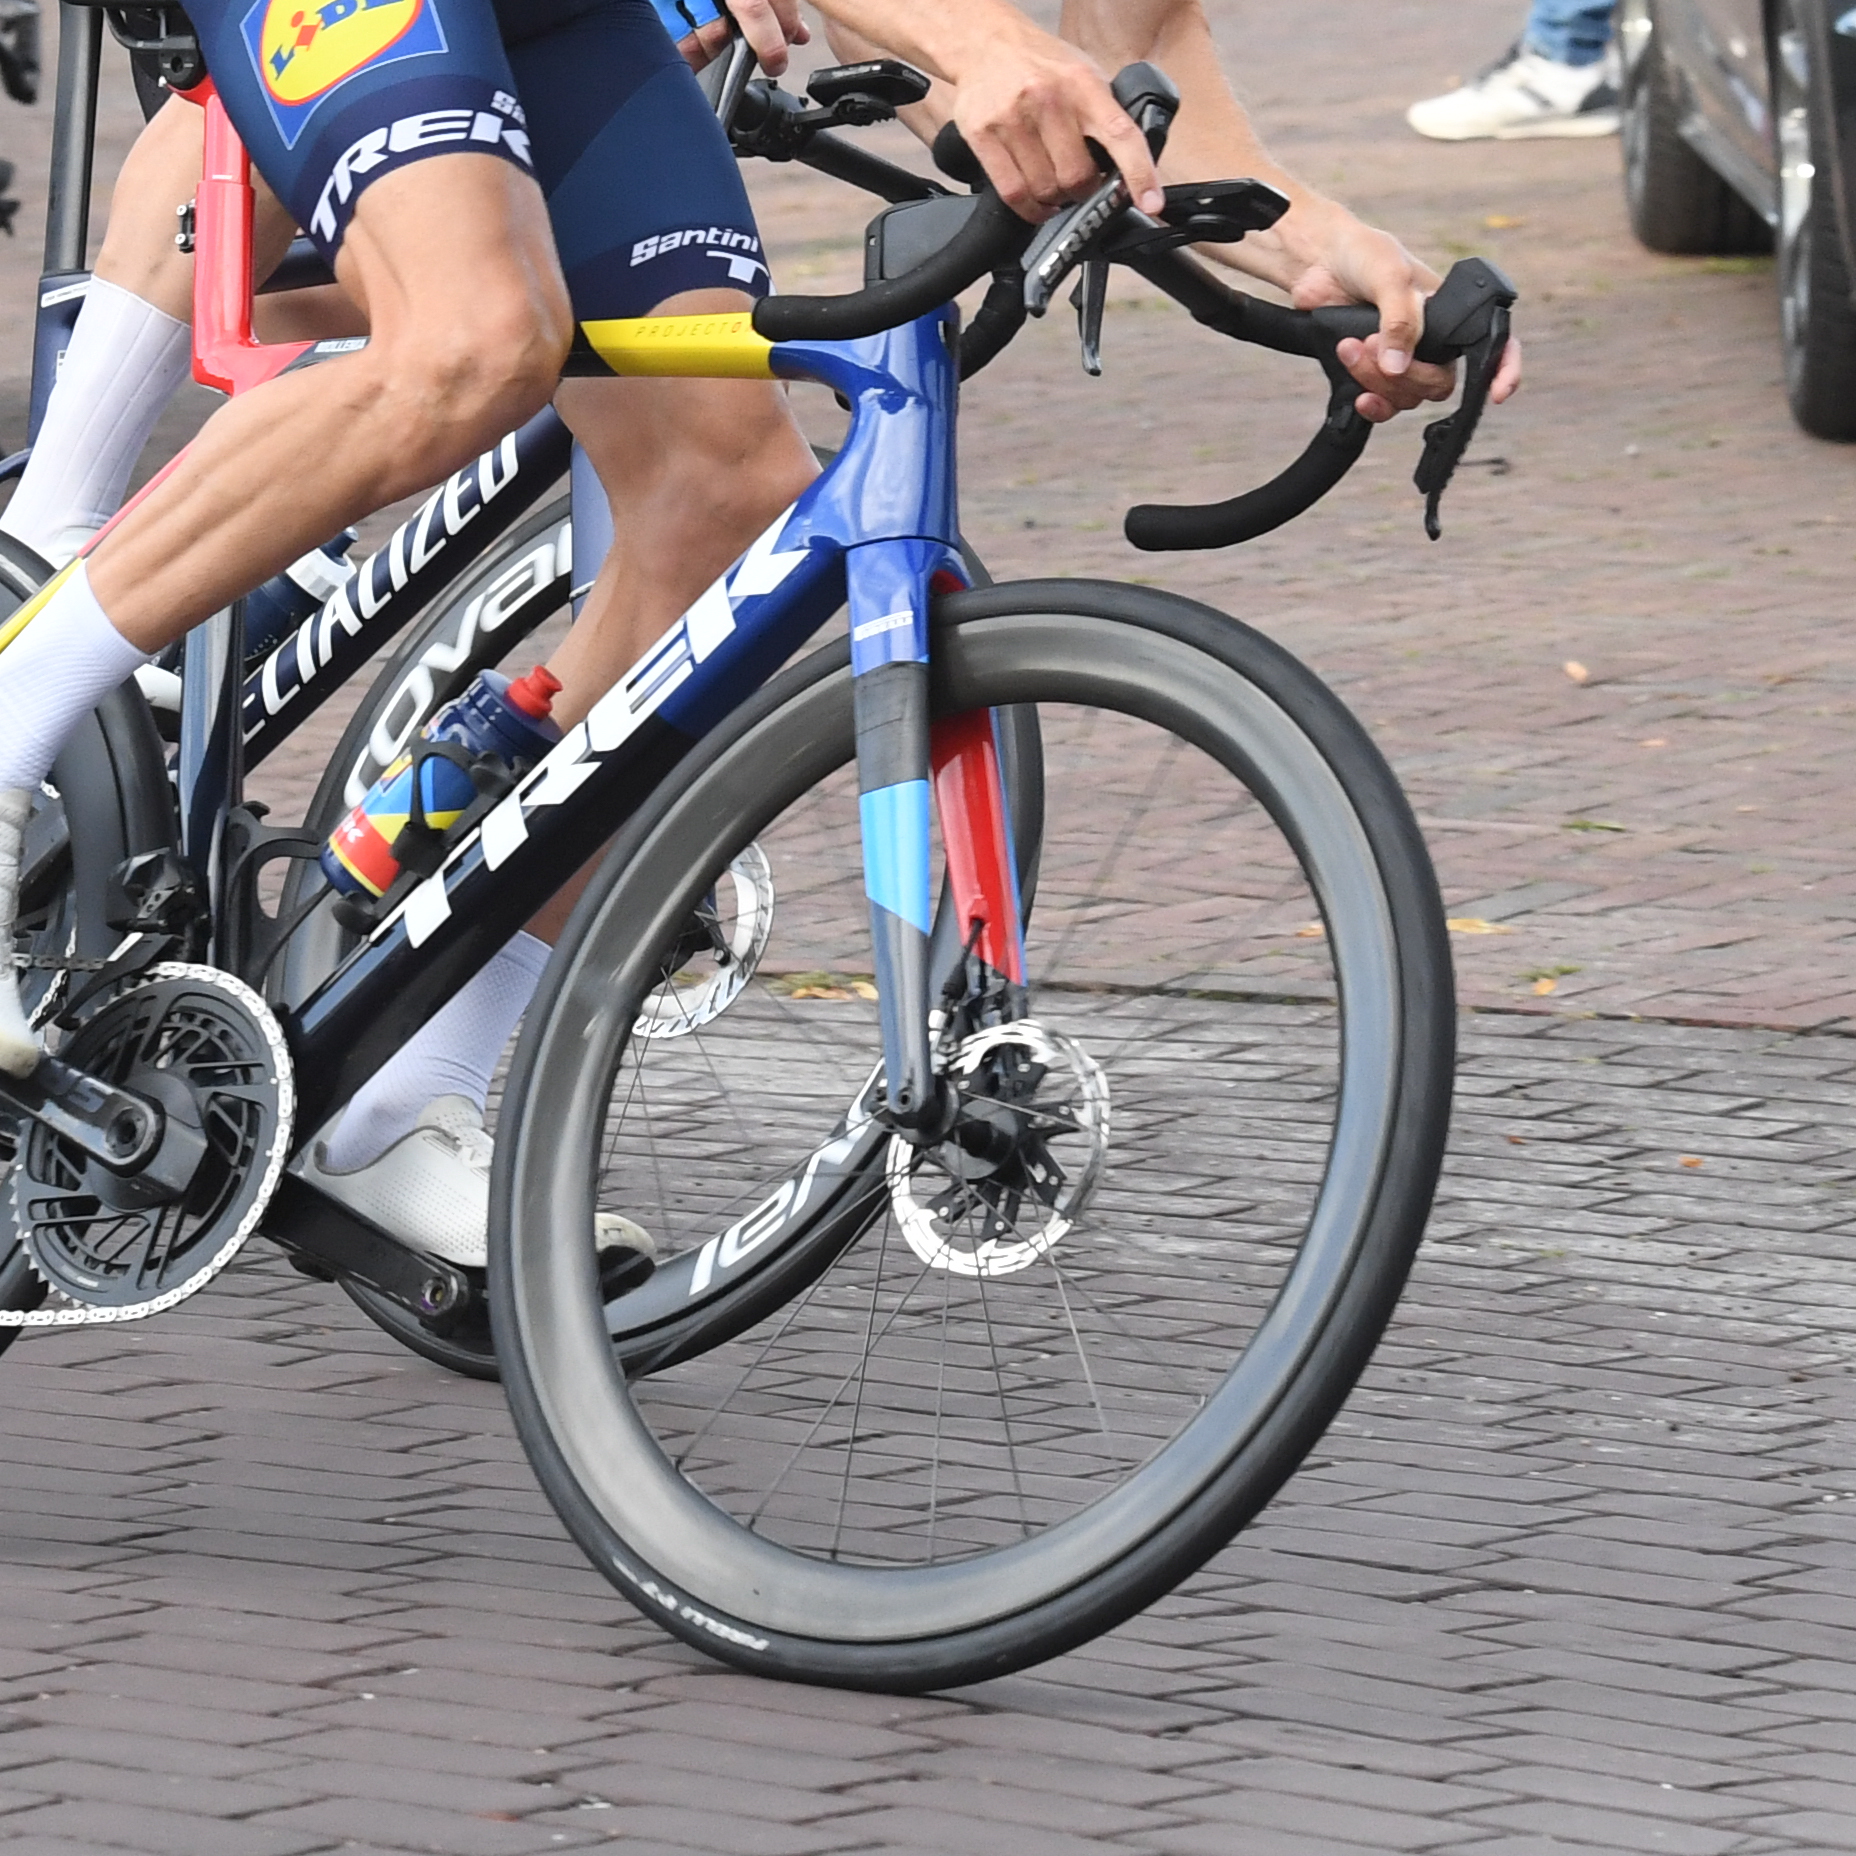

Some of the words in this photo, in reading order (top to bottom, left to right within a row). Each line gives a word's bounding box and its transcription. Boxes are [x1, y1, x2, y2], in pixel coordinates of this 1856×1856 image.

[309, 108, 534, 244] TREK
[629, 226, 760, 268] Santini
[367, 499, 812, 950] TREK
